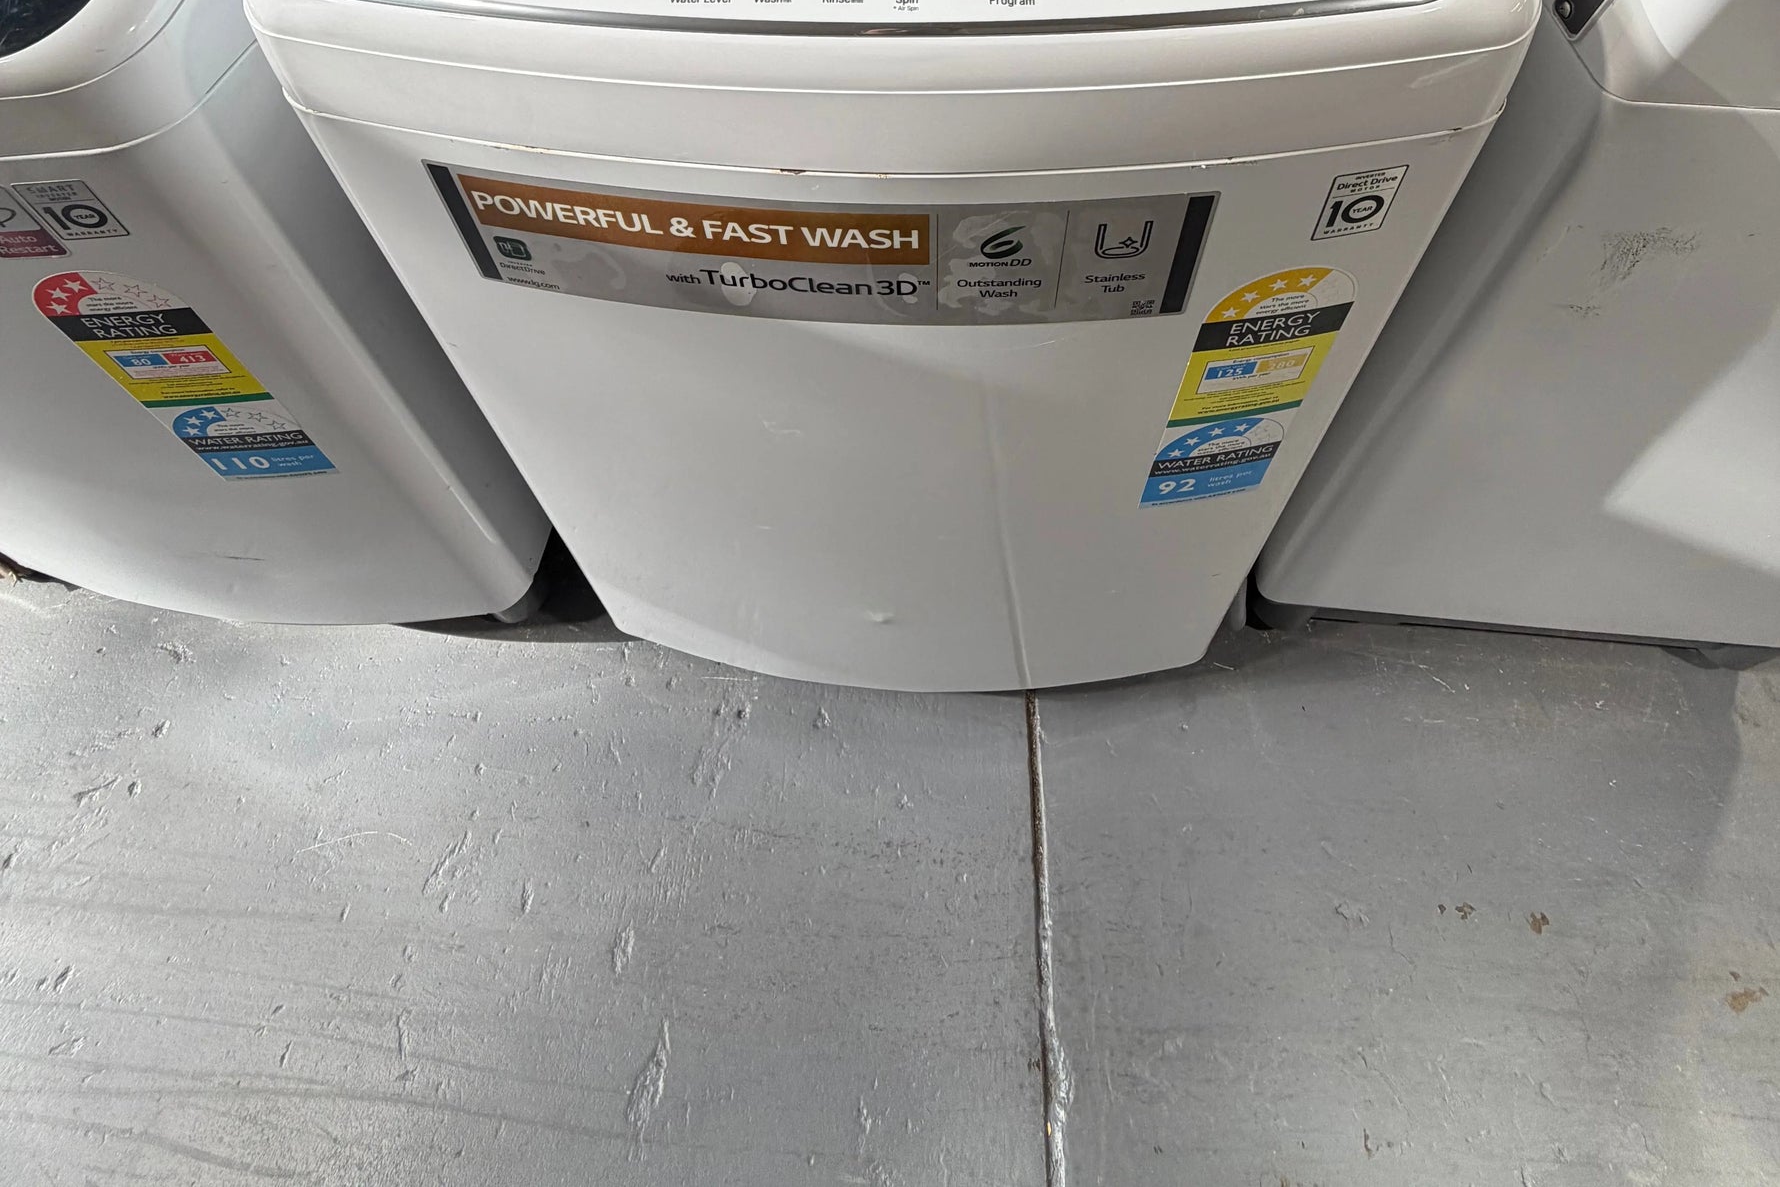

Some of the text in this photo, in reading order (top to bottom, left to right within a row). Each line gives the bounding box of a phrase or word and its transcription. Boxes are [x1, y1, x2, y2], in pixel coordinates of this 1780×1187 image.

[26, 184, 76, 194] SMART
[1336, 176, 1398, 191] Direct Drive
[1326, 194, 1385, 228] 10
[1352, 206, 1374, 214] YEAR
[42, 204, 108, 231] 10
[470, 190, 919, 250] POWERFUL & FAST WASH
[66, 228, 119, 237] WARRANTY
[1324, 223, 1374, 235] WARRANTY
[0, 236, 37, 244] Auto
[0, 244, 59, 254] Restart
[500, 262, 546, 276] DirectDrive
[507, 276, 560, 290] www.lg.com
[666, 272, 701, 285] with
[700, 269, 873, 296] TurboClean
[956, 278, 1042, 289] Outstanding
[1084, 272, 1146, 284] Stainless
[980, 290, 1018, 298] Wash
[1101, 284, 1125, 294] Tub
[80, 314, 165, 328] ENERGY
[1230, 311, 1321, 335] ENERGY
[94, 324, 178, 339] RATING
[1226, 324, 1312, 347] RATING
[130, 354, 206, 366] 80 413
[1217, 369, 1243, 378] 125
[189, 431, 304, 446] WATER RATING
[211, 456, 270, 471] 110
[1158, 456, 1211, 470] WATER
[1216, 444, 1274, 459] RATING
[1158, 478, 1197, 495] 92
